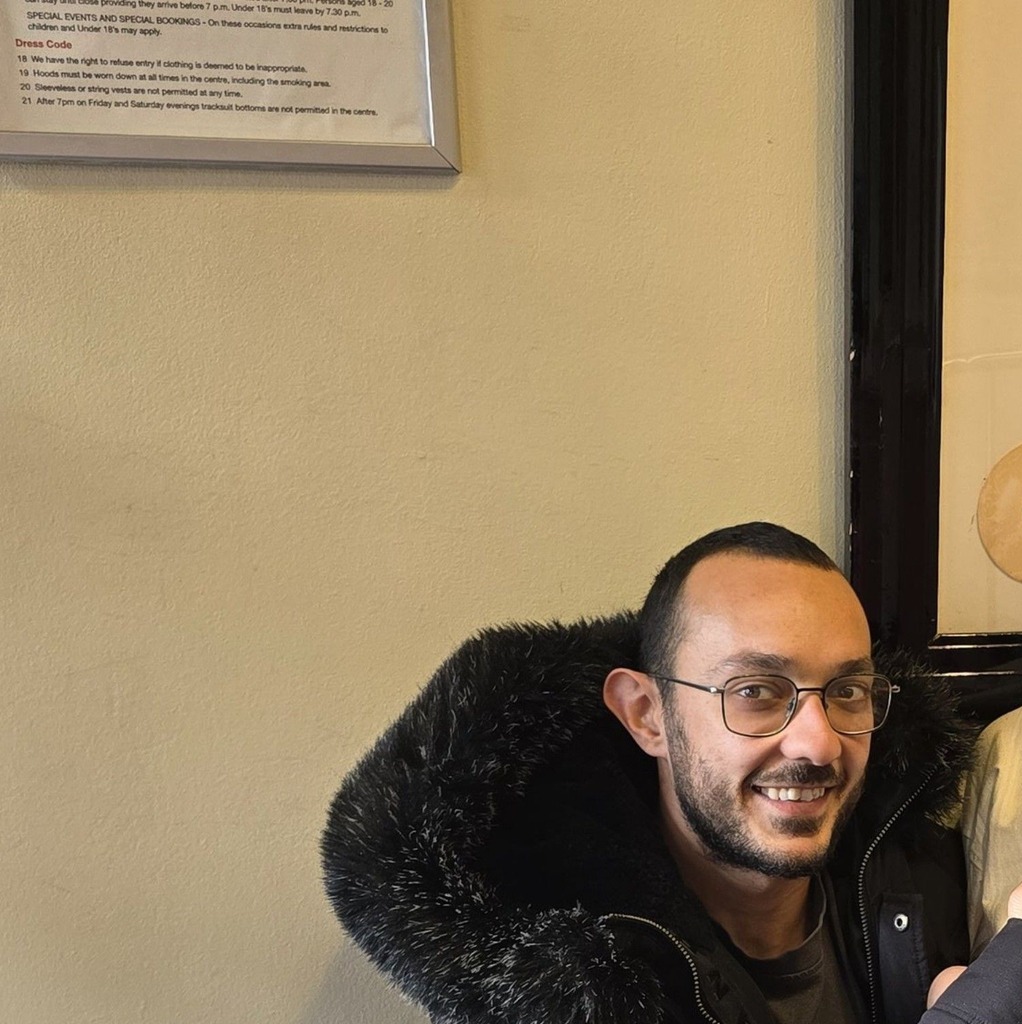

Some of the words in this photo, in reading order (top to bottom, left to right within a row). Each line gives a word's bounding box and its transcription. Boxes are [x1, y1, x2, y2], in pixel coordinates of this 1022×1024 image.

[101, 0, 136, 8] providing
[138, 0, 155, 9] they
[180, 2, 204, 10] before
[231, 4, 254, 12] Under
[257, 5, 272, 13] 18's
[294, 7, 313, 15] leave
[326, 8, 343, 16] 7.30
[344, 9, 361, 17] p.m.
[27, 12, 63, 20] SPECIAL
[65, 13, 98, 21] EVENTS
[119, 15, 155, 24] SPECIAL
[156, 17, 201, 26] BOOKINGS
[221, 20, 242, 28] these
[243, 21, 282, 29] occasions
[339, 25, 379, 33] restrictions
[28, 23, 59, 31] children
[78, 25, 102, 33] Under
[104, 26, 119, 34] 18's
[121, 27, 138, 36] may
[139, 28, 162, 37] apply.
[15, 38, 44, 48] Dress
[46, 40, 72, 49] Code
[18, 55, 28, 63] 18
[31, 55, 44, 63] We
[45, 56, 65, 64] have
[81, 57, 98, 66] right
[110, 58, 134, 66] refuse
[135, 60, 155, 68] entry
[163, 60, 194, 70] clothing
[195, 61, 202, 69] is
[203, 62, 234, 70] deemed
[257, 64, 308, 73] inappropriate.
[19, 69, 29, 77] 19
[33, 69, 60, 78] Hoods
[61, 71, 80, 79] must
[158, 74, 180, 82] times
[189, 75, 202, 83] the
[203, 76, 230, 84] centre,
[231, 77, 265, 86] including
[280, 79, 312, 88] smoking
[20, 83, 31, 91] 20
[34, 83, 76, 92] Sleeveless
[87, 85, 110, 94] string
[161, 88, 198, 96] permitted
[208, 90, 222, 98] any
[21, 97, 32, 105] 21
[36, 97, 55, 105] After
[57, 98, 75, 107] 7pm
[88, 99, 112, 108] Friday
[130, 100, 164, 110] Saturday
[166, 102, 199, 111] evenings
[201, 103, 233, 111] tracksuit
[235, 104, 266, 112] bottoms
[281, 105, 293, 113] not
[294, 106, 330, 114] permitted
[331, 106, 338, 114] in
[339, 107, 352, 115] the
[353, 108, 378, 116] centre.
